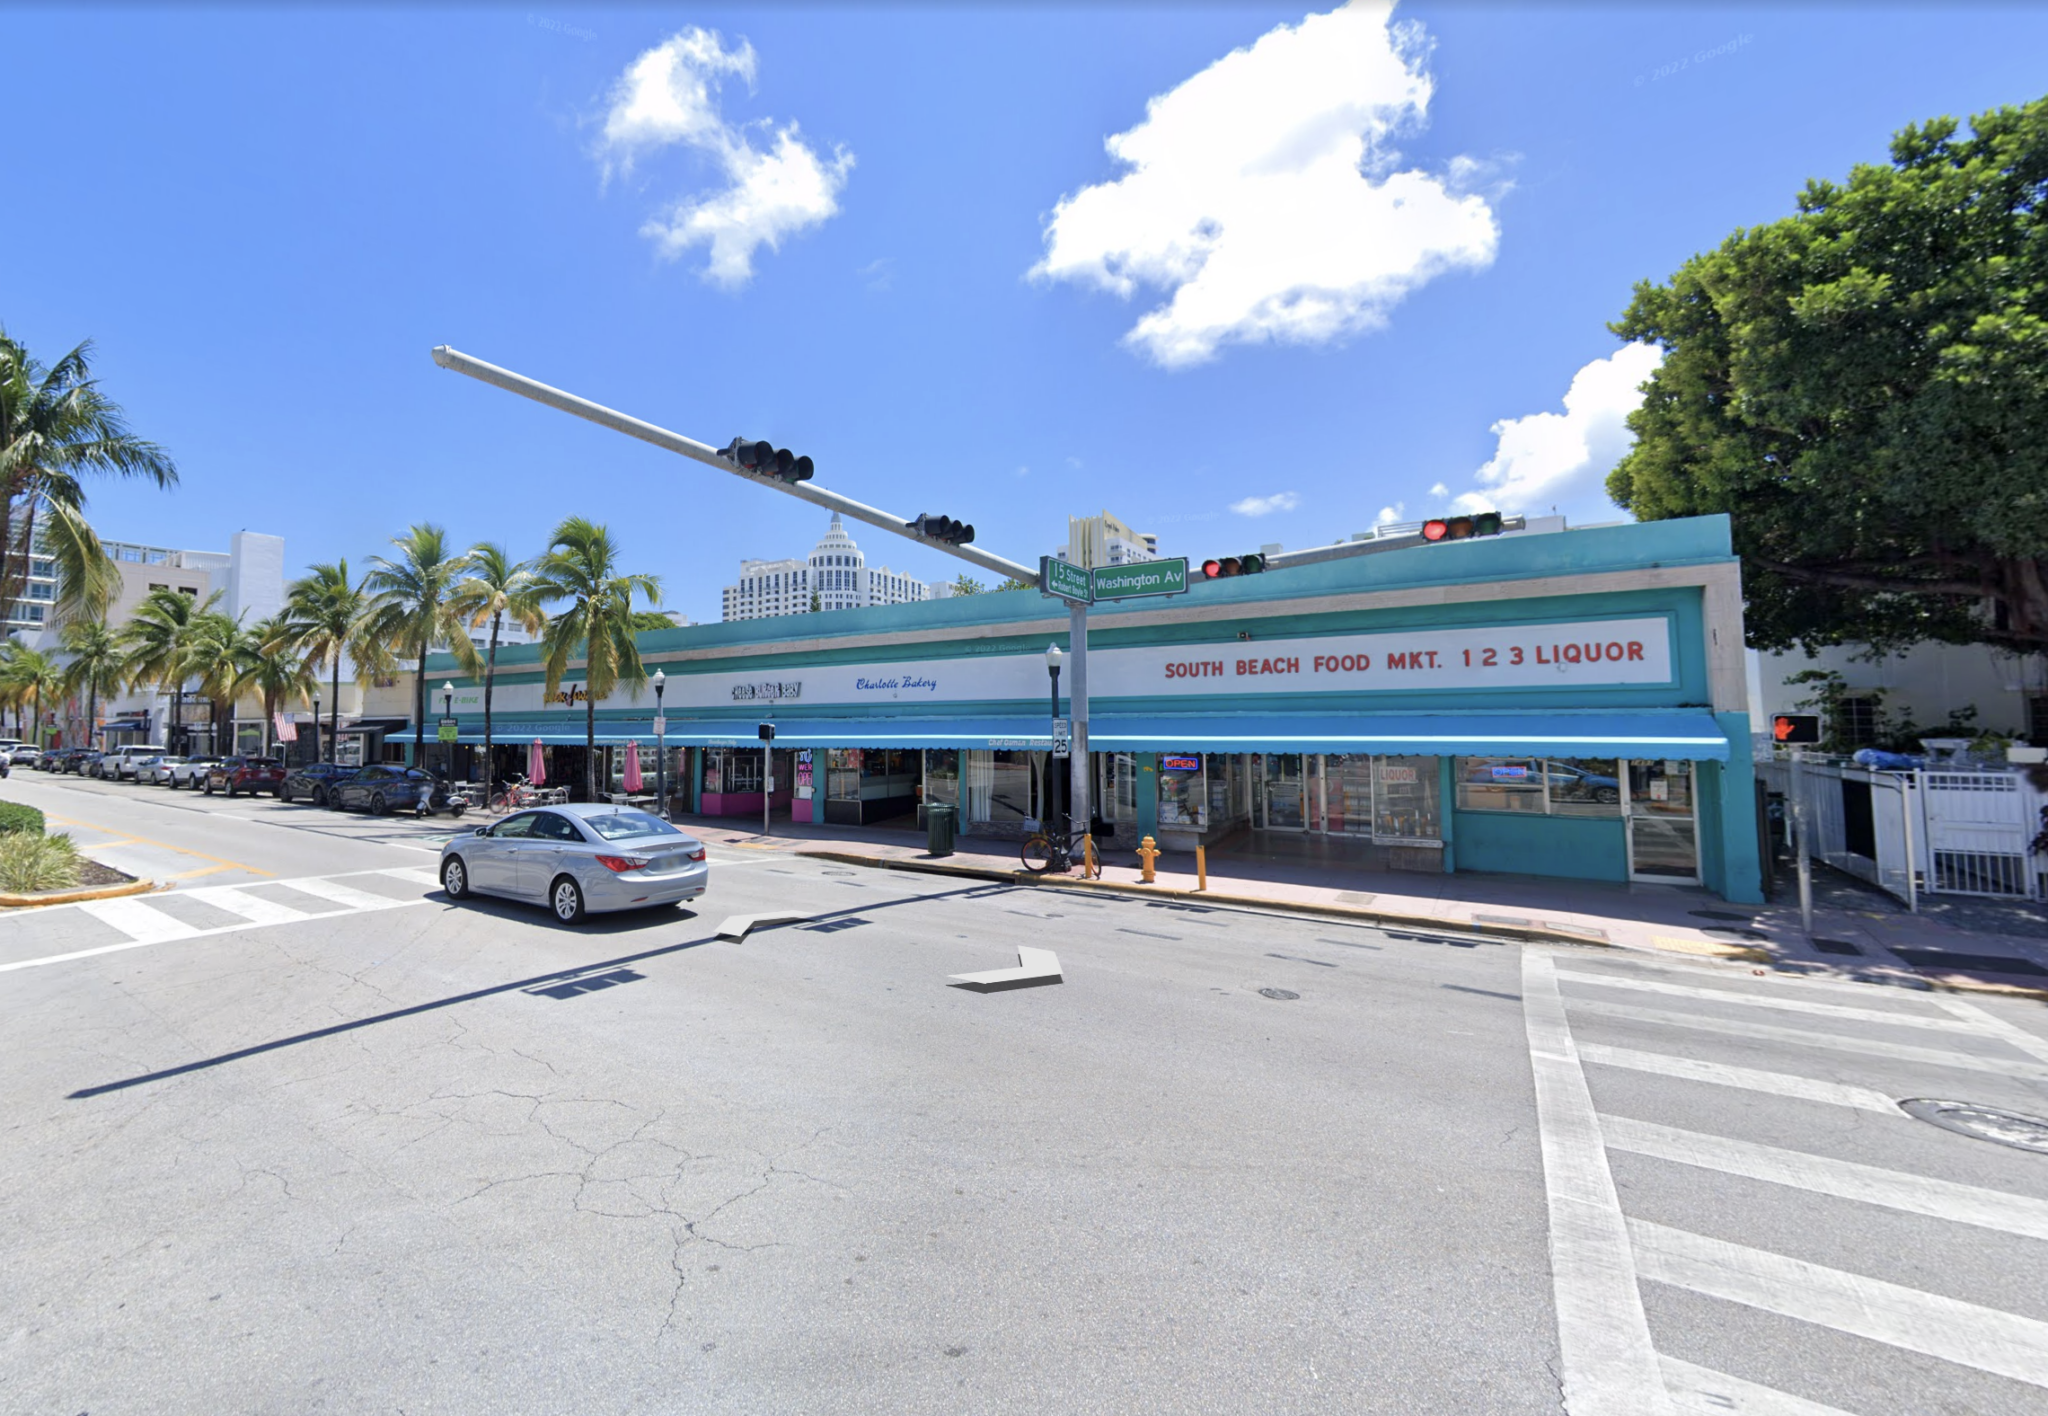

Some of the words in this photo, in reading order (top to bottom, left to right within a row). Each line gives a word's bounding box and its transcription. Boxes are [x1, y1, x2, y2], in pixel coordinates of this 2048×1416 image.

[1066, 569, 1086, 587] Street
[1096, 573, 1160, 590] Washington
[1164, 571, 1182, 583] Av
[1165, 661, 1223, 678] SOUTH
[1236, 657, 1300, 675] BEACH
[1314, 654, 1371, 672] FOOD
[1387, 651, 1443, 669] MKT.
[1536, 641, 1644, 664] LIQUOR
[856, 678, 899, 690] Charlotte
[902, 676, 937, 692] Bakery
[1054, 739, 1067, 753] 25
[1165, 759, 1196, 768] OPEN
